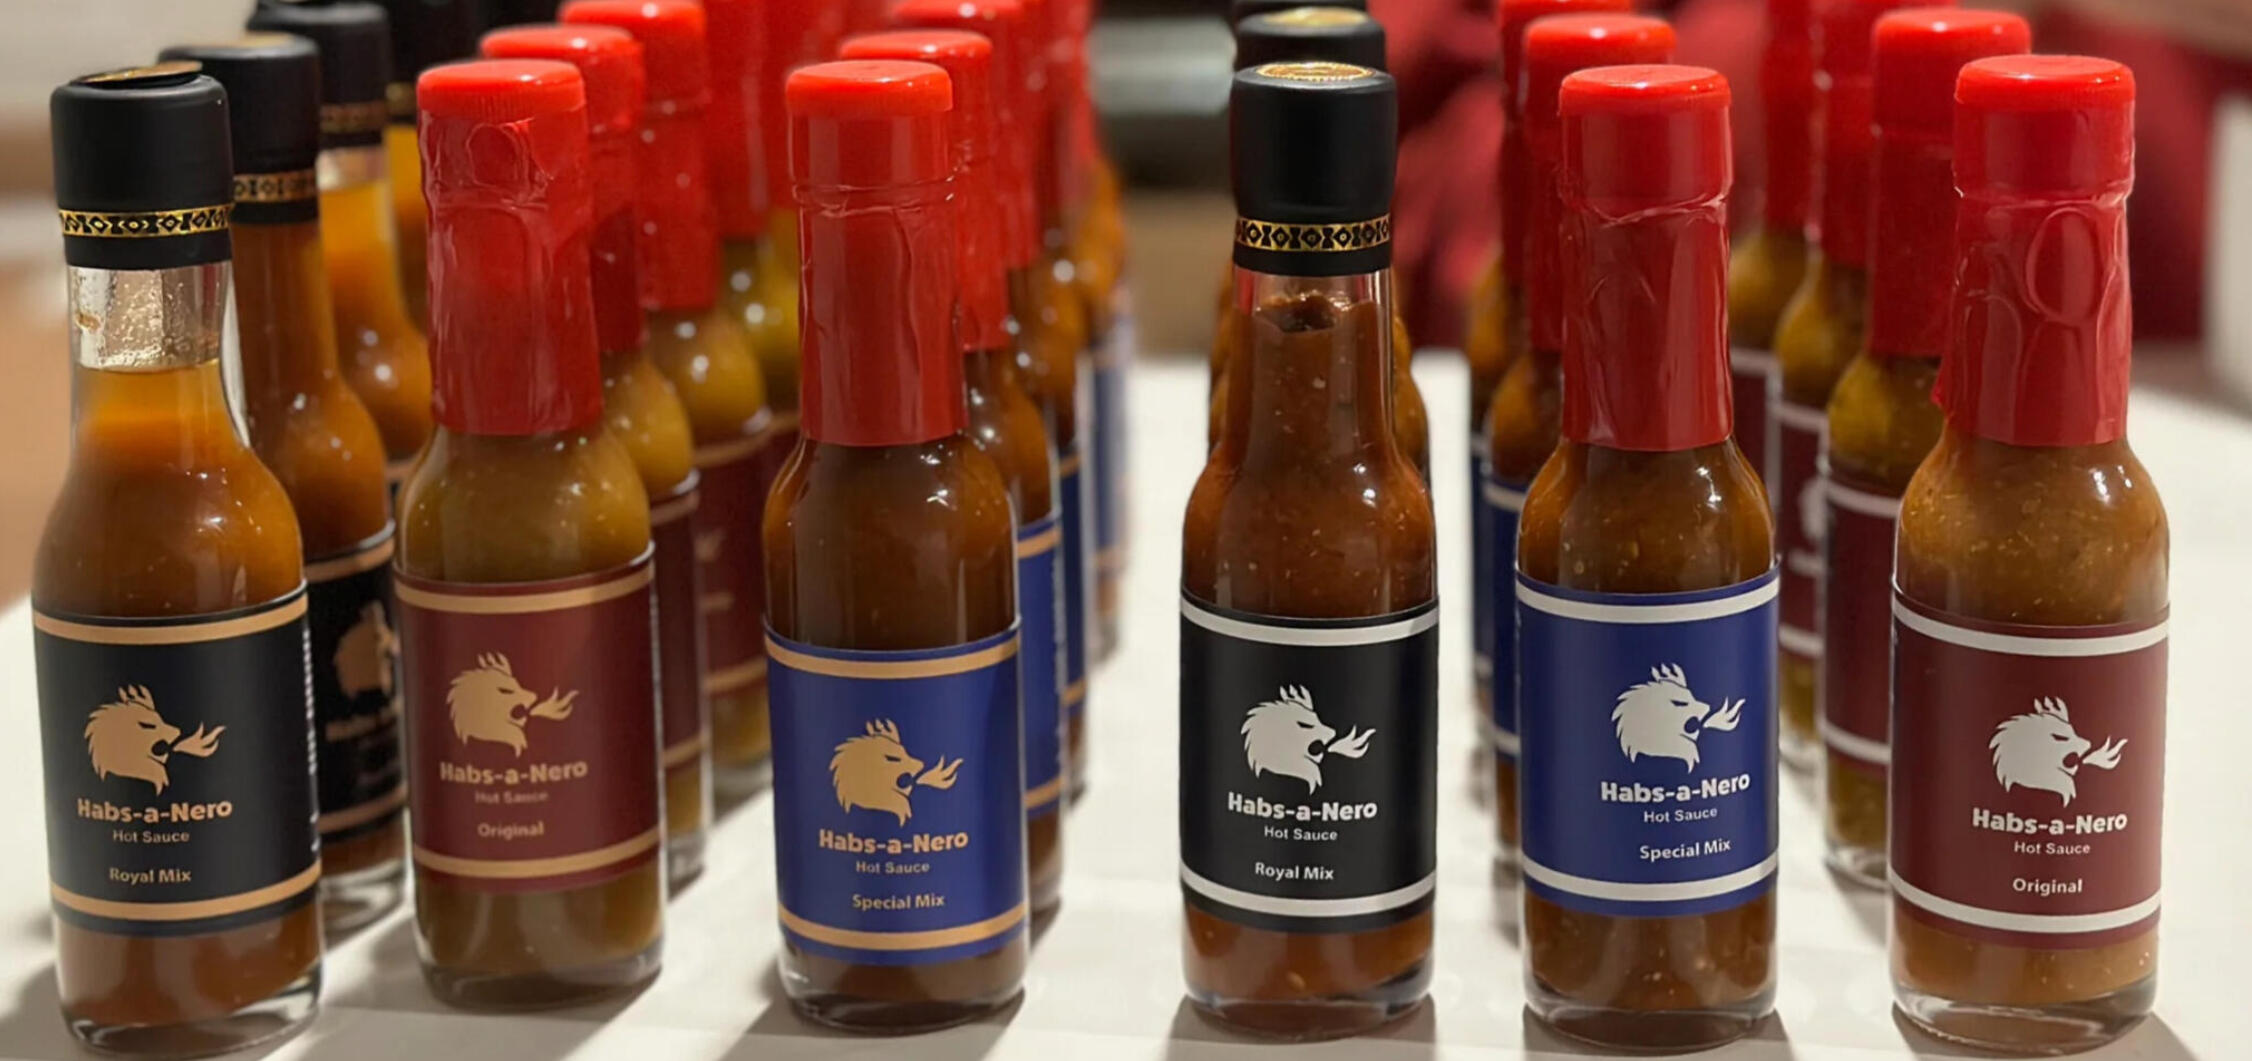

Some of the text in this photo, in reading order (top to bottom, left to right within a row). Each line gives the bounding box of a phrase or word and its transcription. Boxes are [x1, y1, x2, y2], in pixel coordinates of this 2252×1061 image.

[439, 761, 588, 785] Habs-a-Nero
[475, 790, 499, 803] Hot
[1600, 773, 1750, 803] Habs-a-Nero
[77, 798, 233, 823] Habs-a-Nero
[1228, 791, 1378, 821] Habs-a-Nero
[1644, 807, 1717, 823] Hot Sauce
[477, 820, 544, 841] Original
[1972, 807, 2128, 835] Habs-a-Nero
[113, 829, 190, 843] Hot Sauce
[819, 828, 969, 854] Habs-a-Nero
[1264, 825, 1338, 841] Hot Sauce
[1639, 838, 1731, 863] Special Mix
[2014, 841, 2091, 855] Hot Sauce
[109, 867, 192, 885] Royal Mix
[855, 861, 930, 874] Hot Sauce
[1255, 861, 1334, 881] Royal Mix
[2012, 877, 2083, 897] Original
[852, 893, 945, 911] Special Mix
